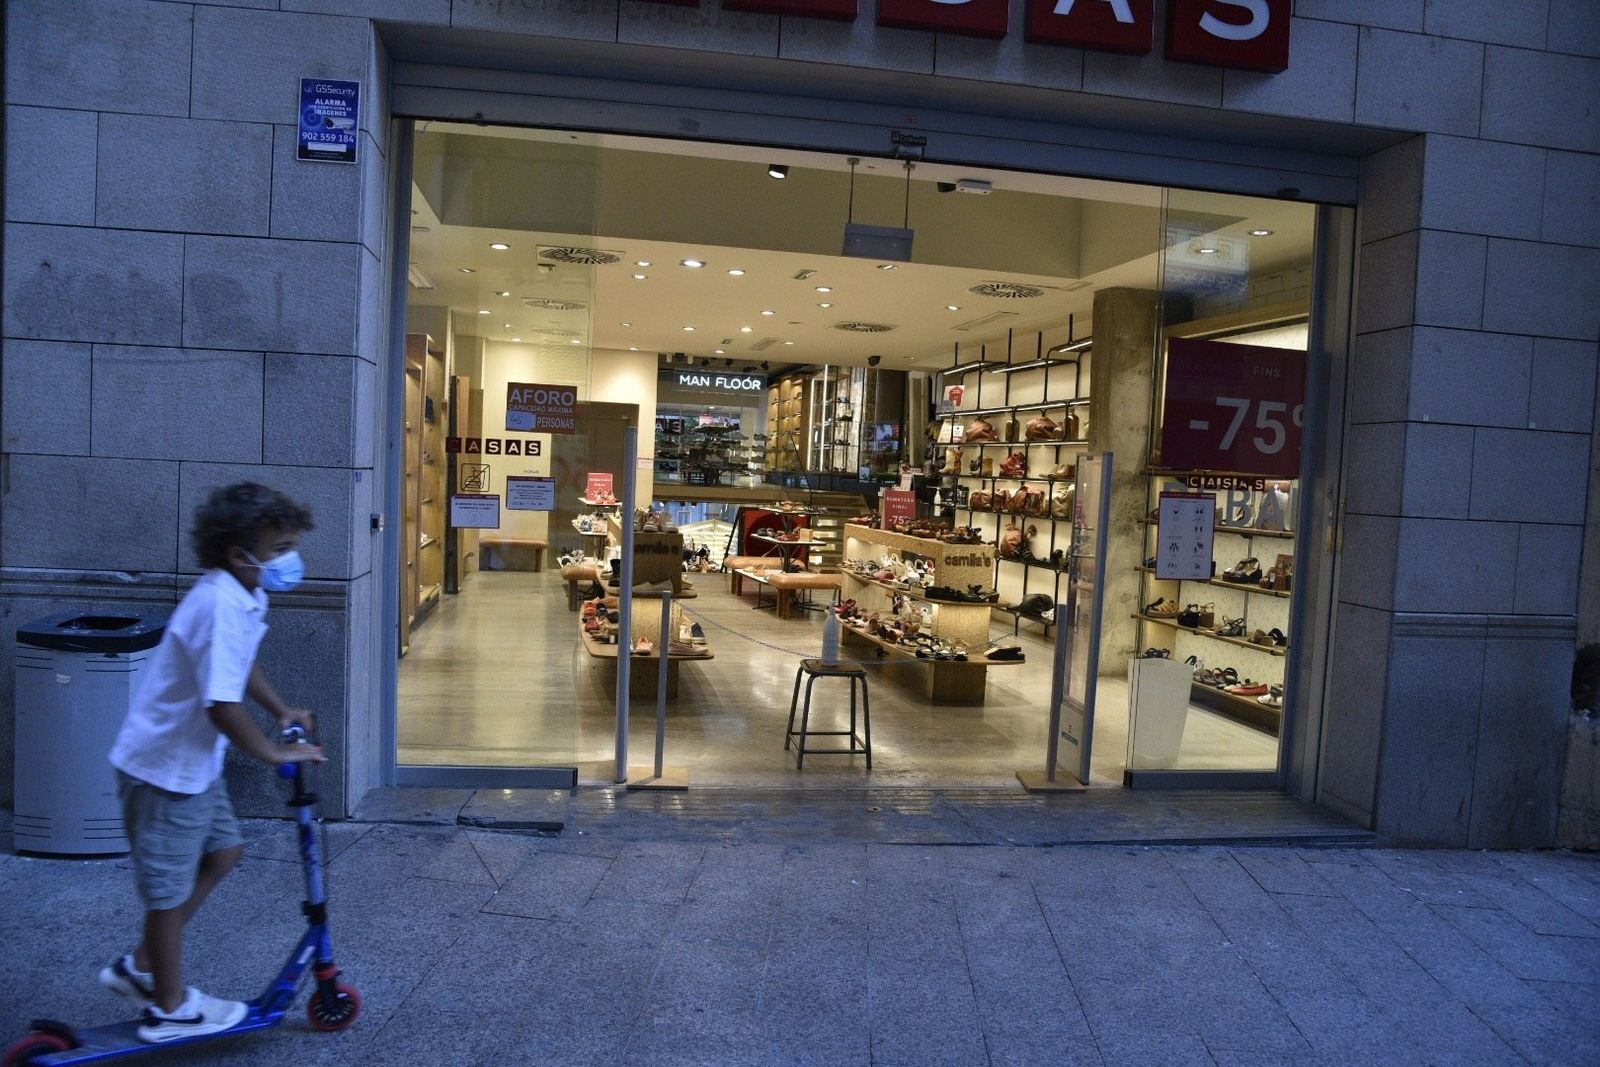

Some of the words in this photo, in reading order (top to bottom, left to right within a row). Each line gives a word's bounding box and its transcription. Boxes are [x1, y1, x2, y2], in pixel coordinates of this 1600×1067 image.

[315, 84, 356, 97] GSSecurity
[315, 98, 346, 107] ALARMA
[302, 132, 318, 141] 902
[320, 133, 336, 142] 559
[339, 134, 354, 143] 184
[1252, 366, 1281, 377] FINS
[679, 374, 710, 387] MAN
[509, 388, 575, 406] AFORO
[509, 403, 546, 412] CAPACIDAD
[537, 416, 575, 429] PERSONAS
[1189, 476, 1264, 490] CASAS
